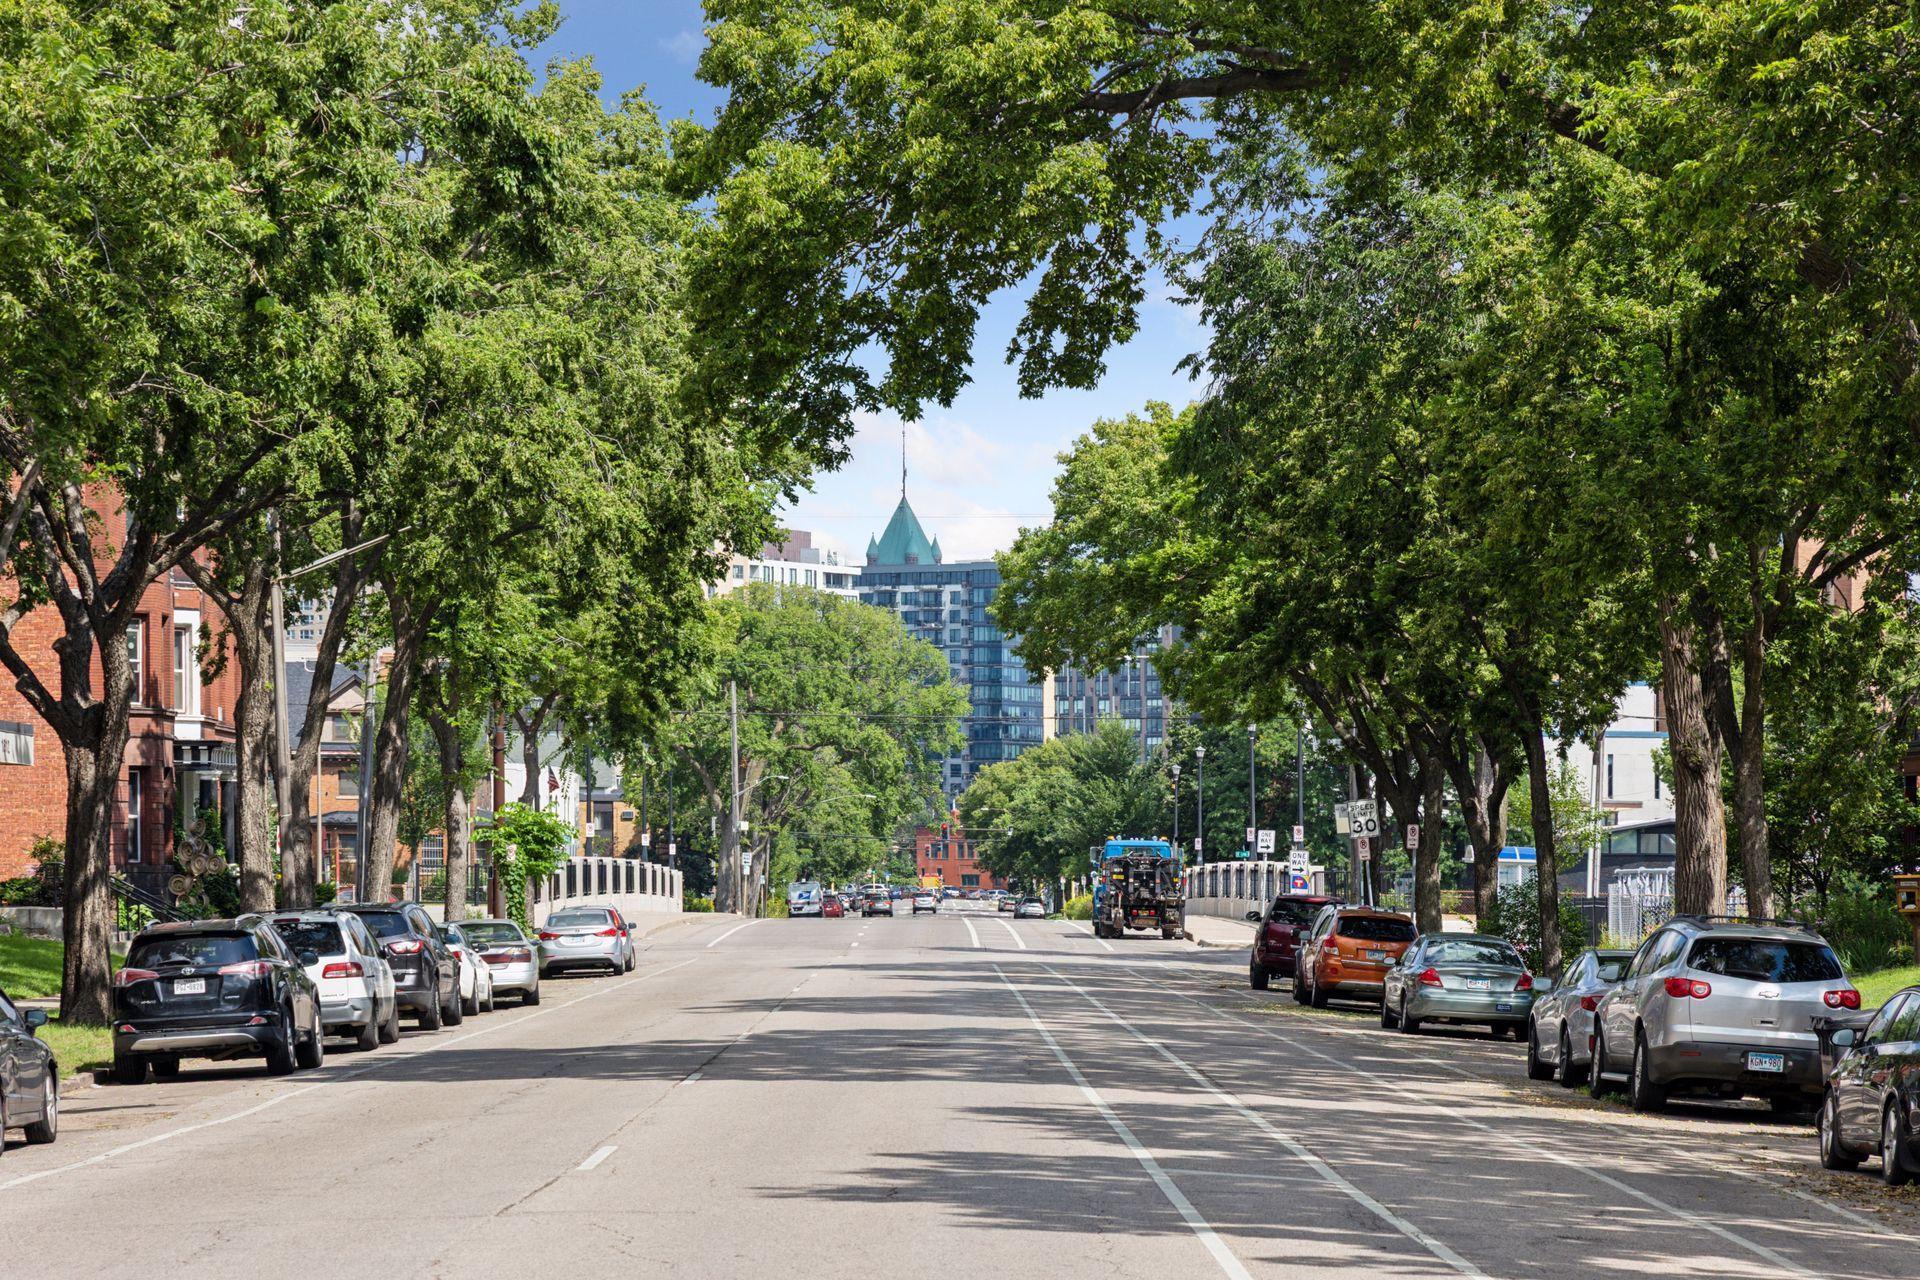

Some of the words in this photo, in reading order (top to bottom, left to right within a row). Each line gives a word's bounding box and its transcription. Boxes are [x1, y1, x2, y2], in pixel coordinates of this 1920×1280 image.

[1350, 803, 1375, 811] SPEED
[1353, 810, 1373, 819] LIMIT
[1352, 819, 1377, 833] 30
